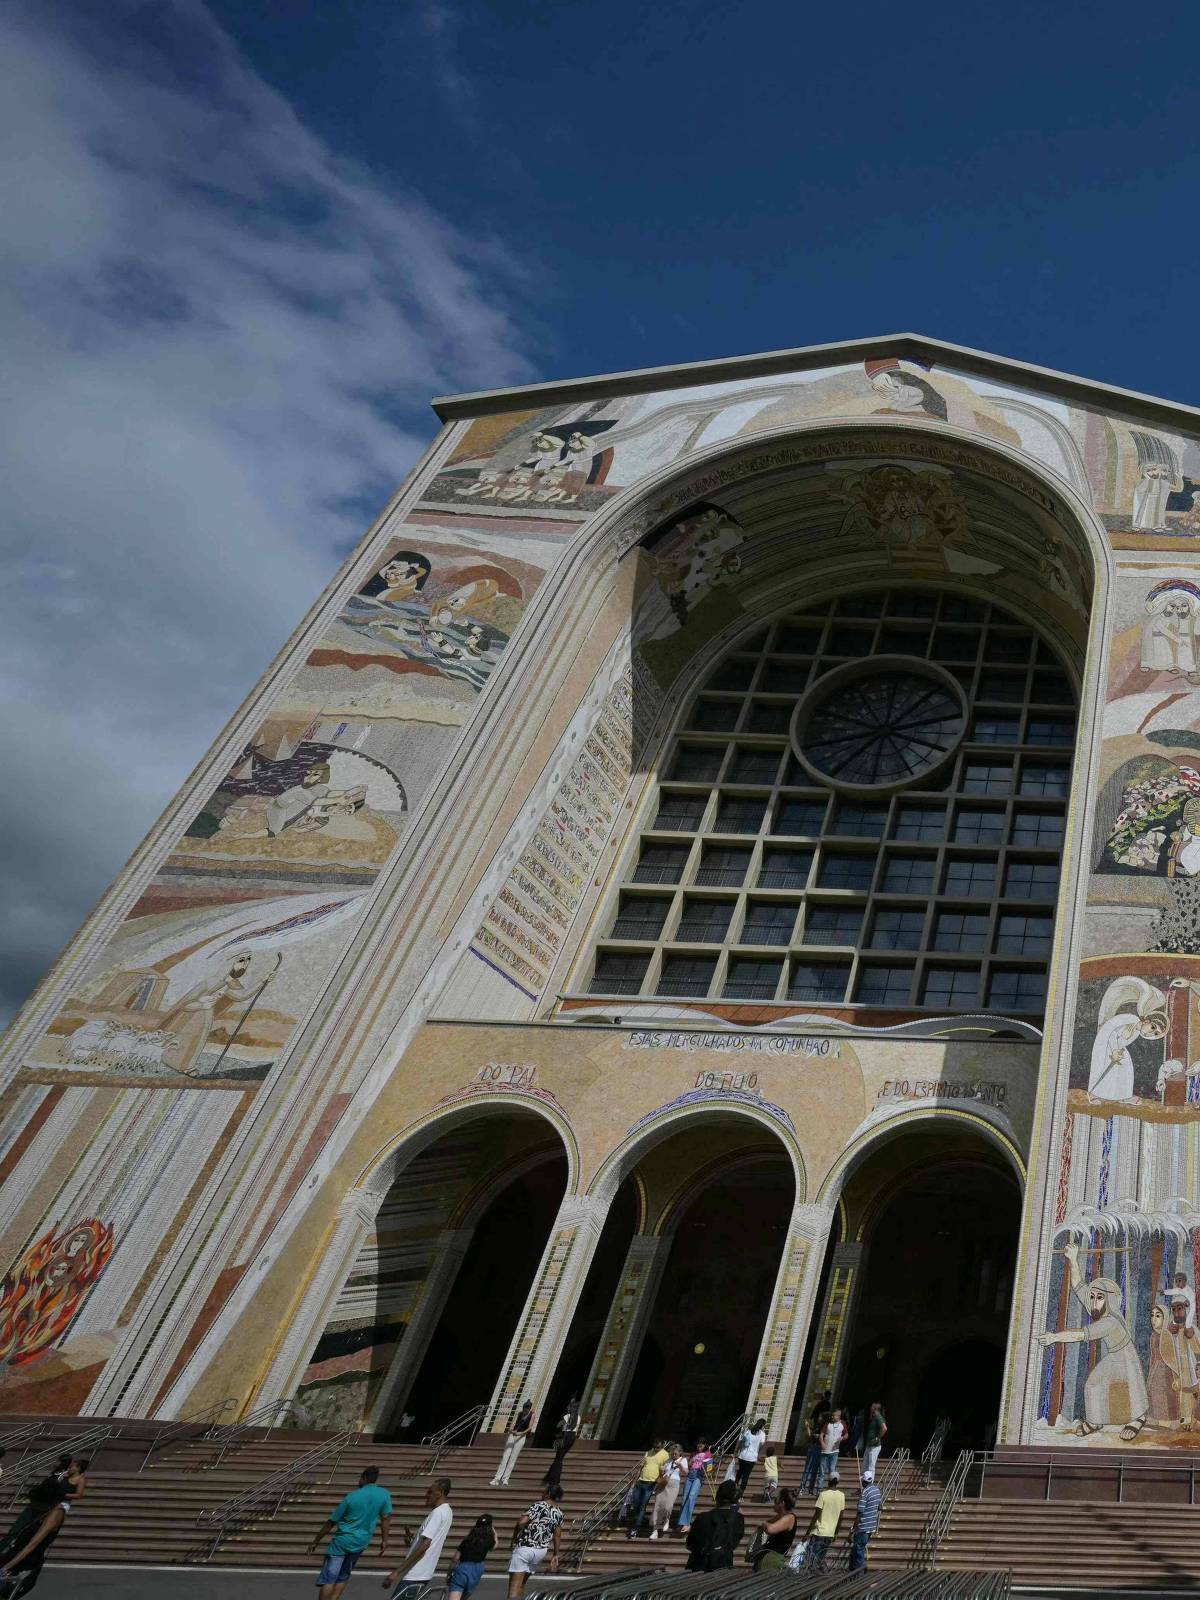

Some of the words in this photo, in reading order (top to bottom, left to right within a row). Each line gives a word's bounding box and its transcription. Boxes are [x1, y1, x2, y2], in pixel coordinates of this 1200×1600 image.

[666, 1033, 745, 1050] MERGULHADOS
[479, 1064, 502, 1081] DO
[509, 1065, 537, 1085] PAI
[695, 1070, 715, 1088] DO
